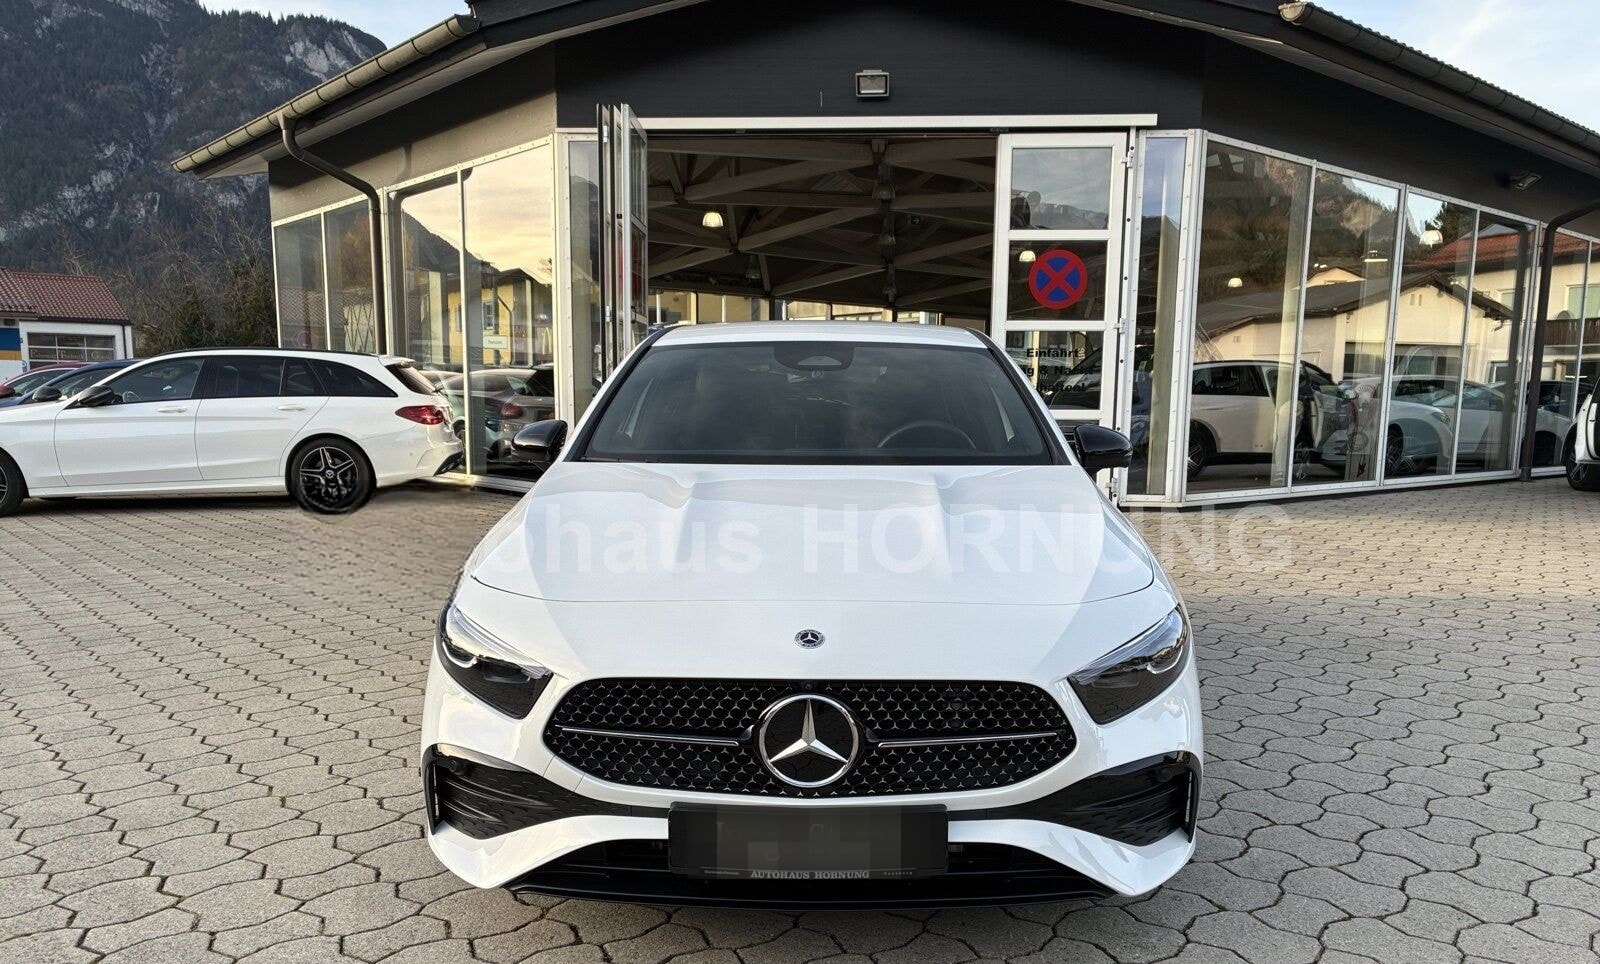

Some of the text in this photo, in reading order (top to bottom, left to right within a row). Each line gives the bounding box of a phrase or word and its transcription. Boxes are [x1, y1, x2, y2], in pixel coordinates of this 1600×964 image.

[1026, 348, 1079, 358] Einfahrt
[750, 869, 810, 880] AUTOHAUS
[814, 869, 870, 880] HORNUNG
